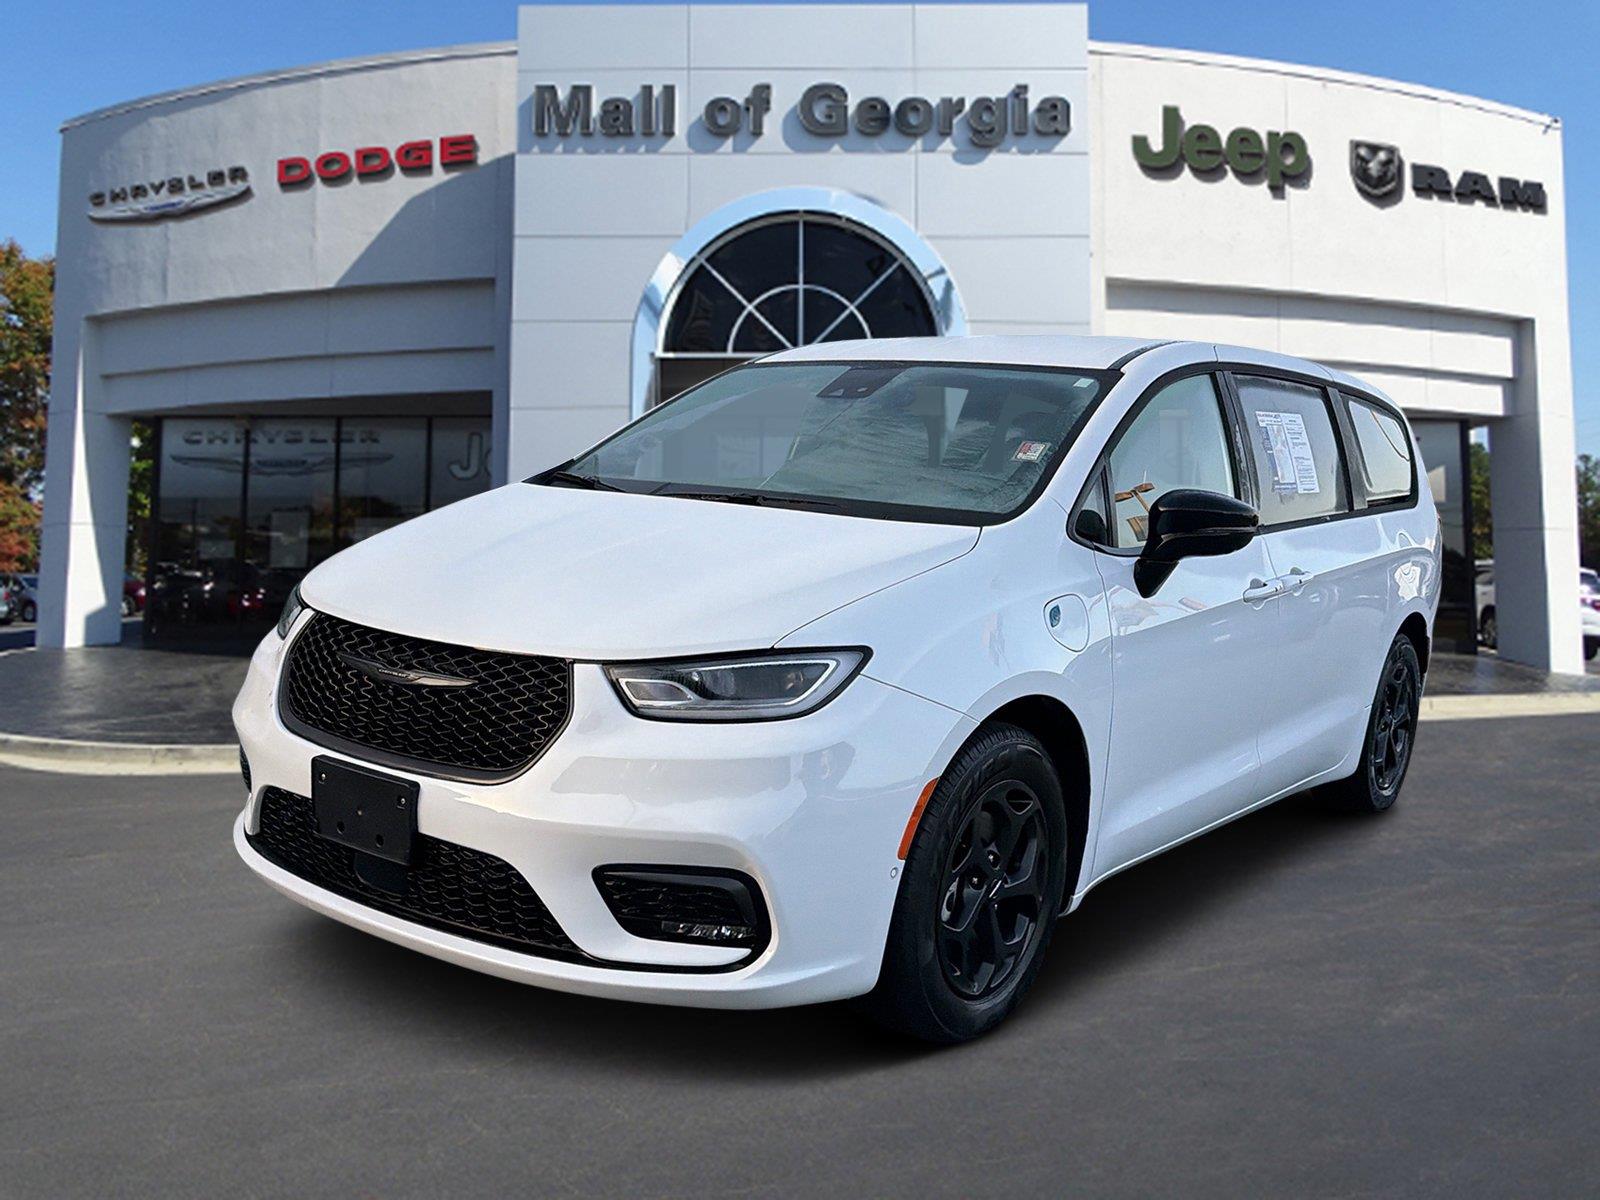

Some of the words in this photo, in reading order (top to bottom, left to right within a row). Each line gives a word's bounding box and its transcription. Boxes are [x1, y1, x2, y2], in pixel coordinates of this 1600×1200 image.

[532, 84, 677, 137] Mall
[703, 84, 772, 137] of
[799, 83, 1073, 149] Georgia
[277, 134, 476, 187] DODGE
[1131, 105, 1308, 190] Jeep
[89, 165, 249, 207] CHRYSLER
[1411, 163, 1546, 212] RAM
[183, 429, 380, 444] CHRYSLER
